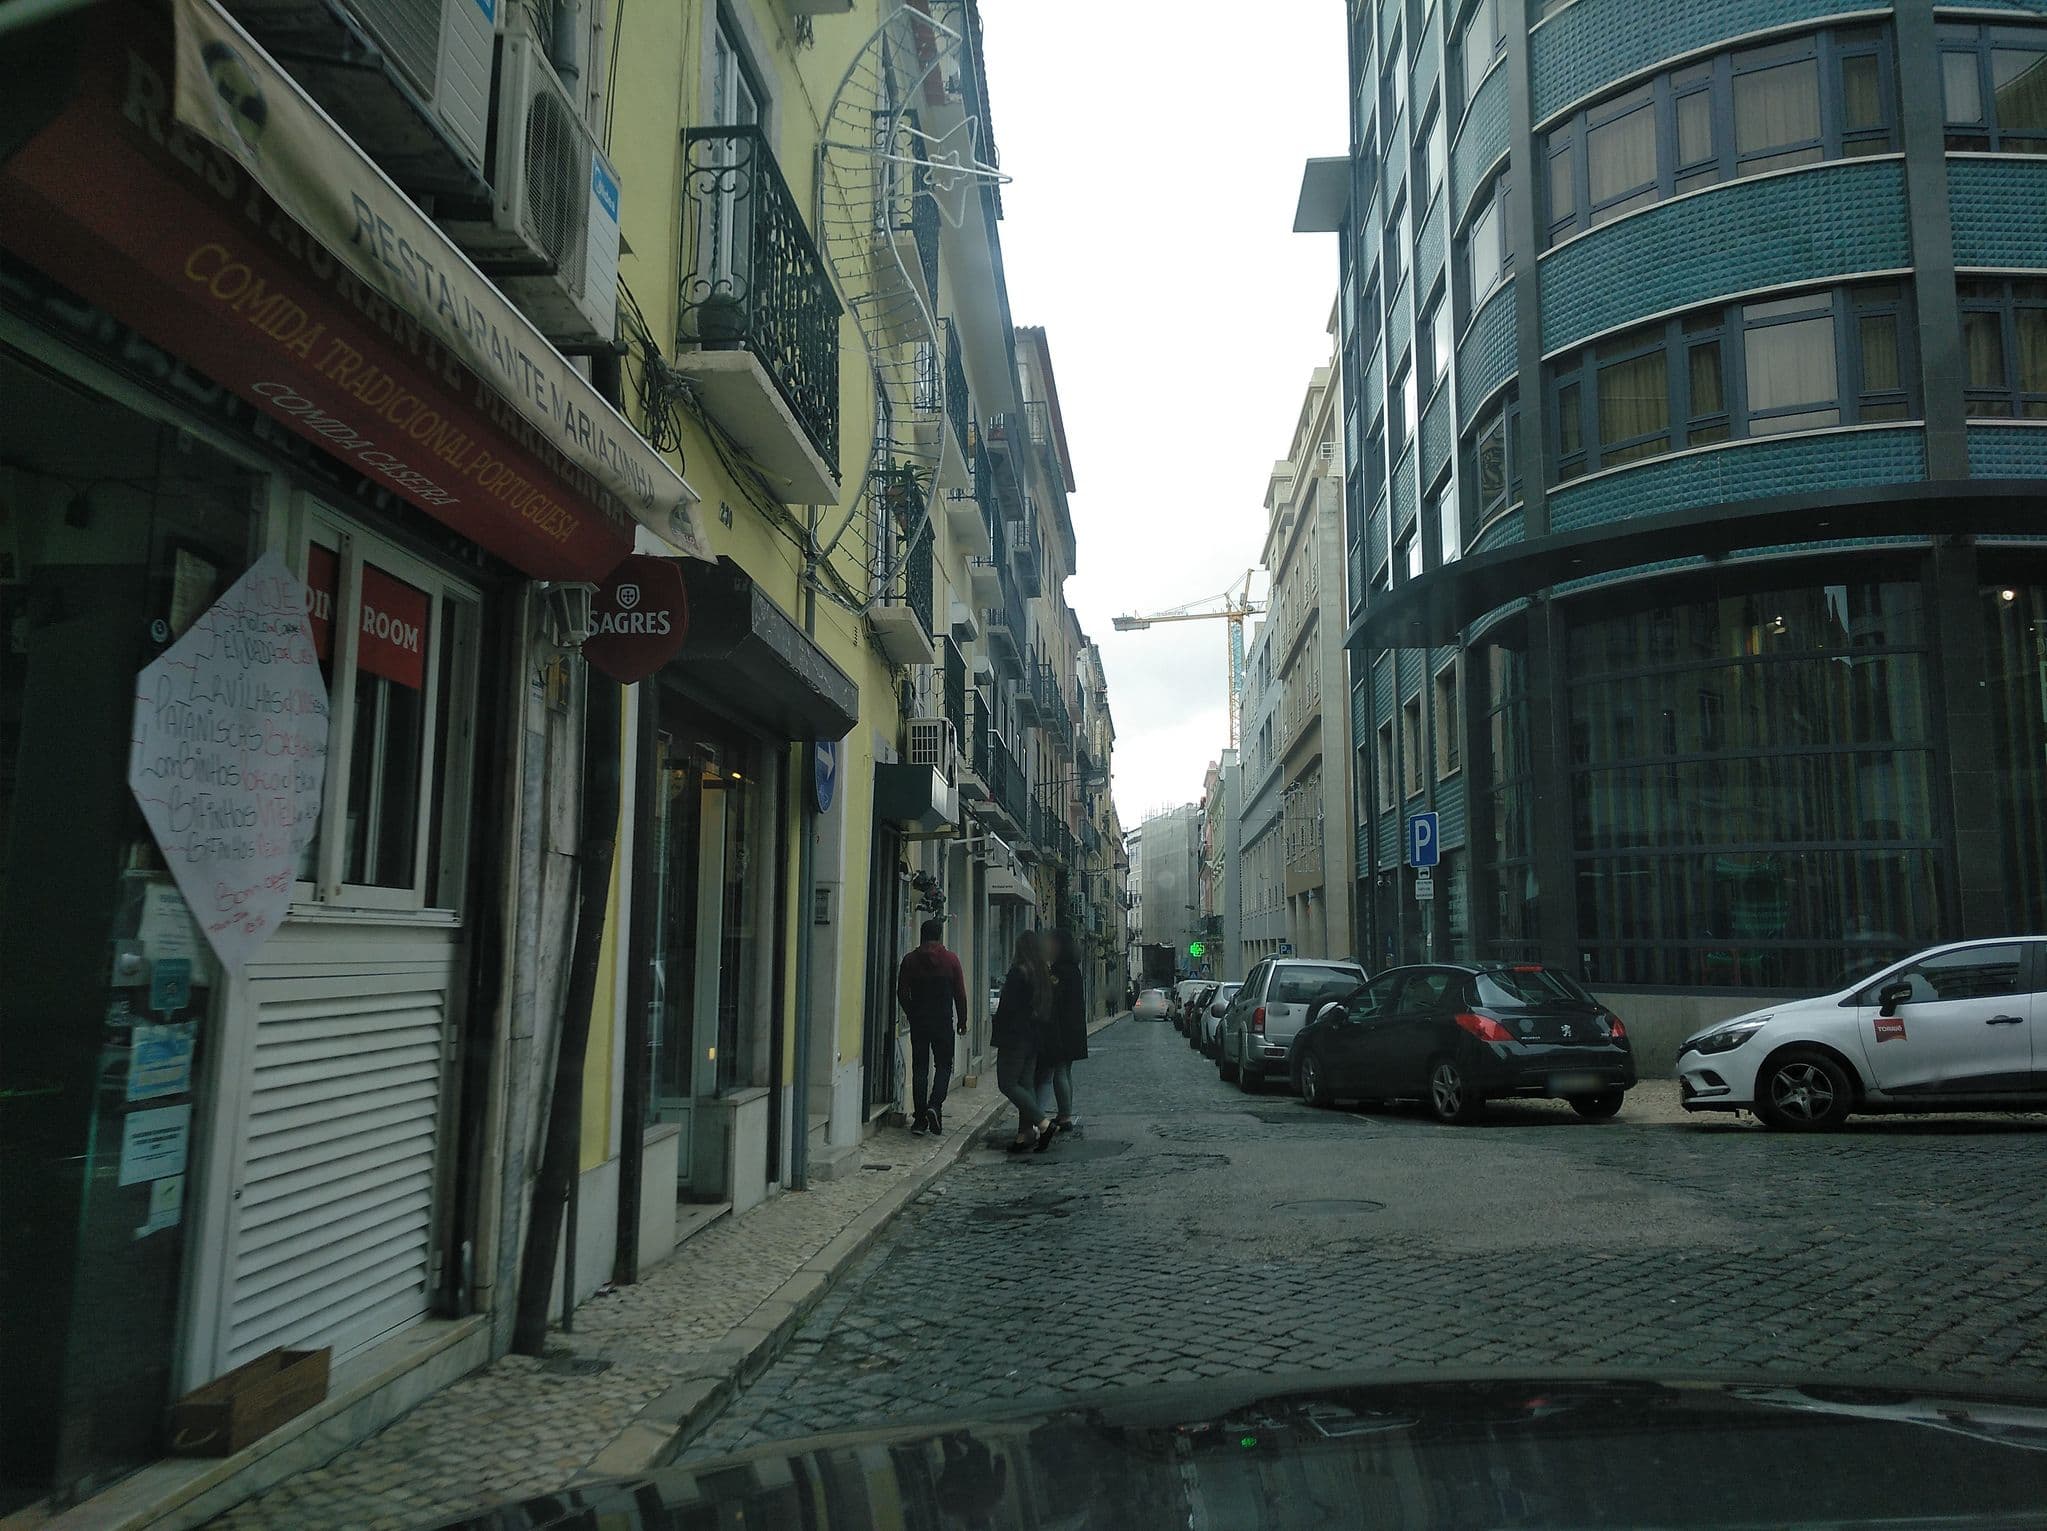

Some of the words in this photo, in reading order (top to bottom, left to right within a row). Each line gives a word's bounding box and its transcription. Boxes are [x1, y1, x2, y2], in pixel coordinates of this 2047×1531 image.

[184, 242, 327, 360] COMIDA
[314, 335, 468, 468] TRADICIONAL
[463, 448, 582, 545] PORTUGUESA
[351, 190, 549, 415] RESTAURANTE
[550, 380, 656, 510] MARIAZINHA
[250, 381, 374, 453] COMIDA
[358, 450, 462, 507] CASEIRA
[362, 605, 418, 653] ROOM
[589, 609, 671, 637] SAGRES
[1414, 818, 1432, 863] P
